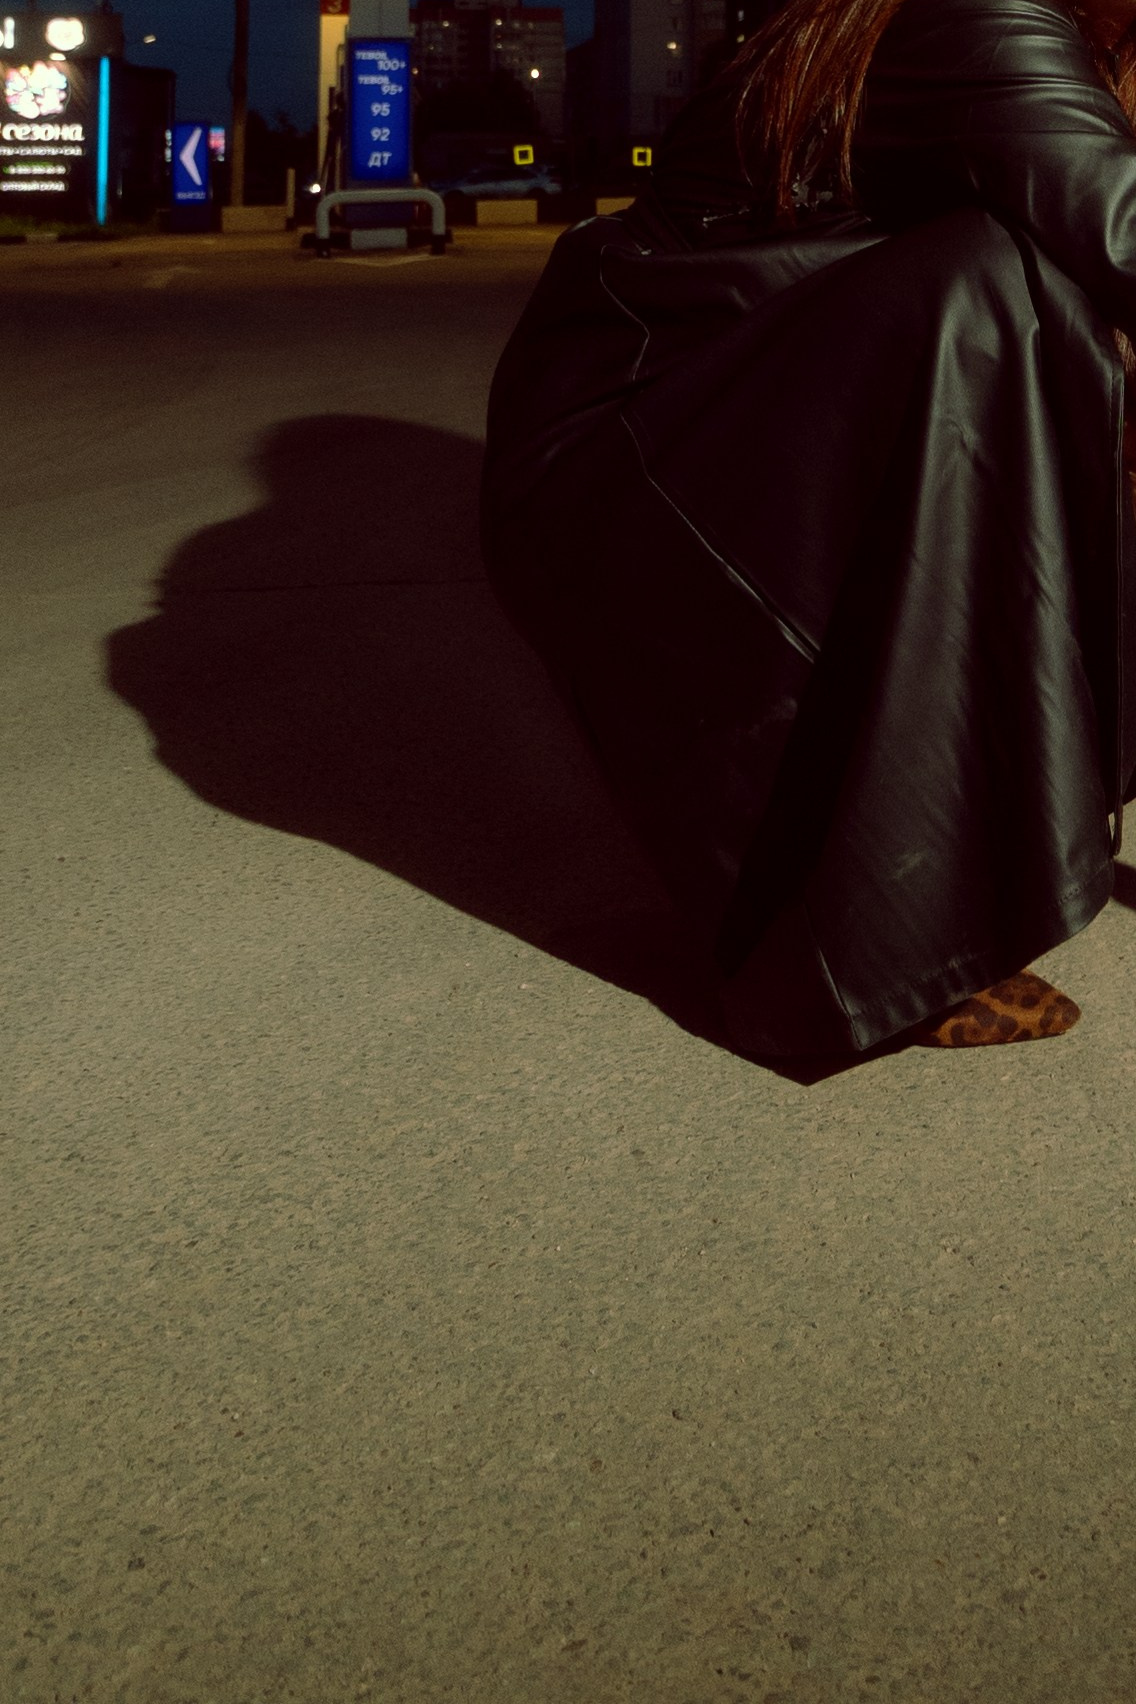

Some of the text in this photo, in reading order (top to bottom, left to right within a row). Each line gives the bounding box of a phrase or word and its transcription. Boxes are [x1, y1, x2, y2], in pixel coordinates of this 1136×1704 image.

[377, 58, 406, 71] 100+
[370, 102, 391, 117] 95
[370, 127, 391, 141] 92
[368, 151, 393, 168] ДТ
